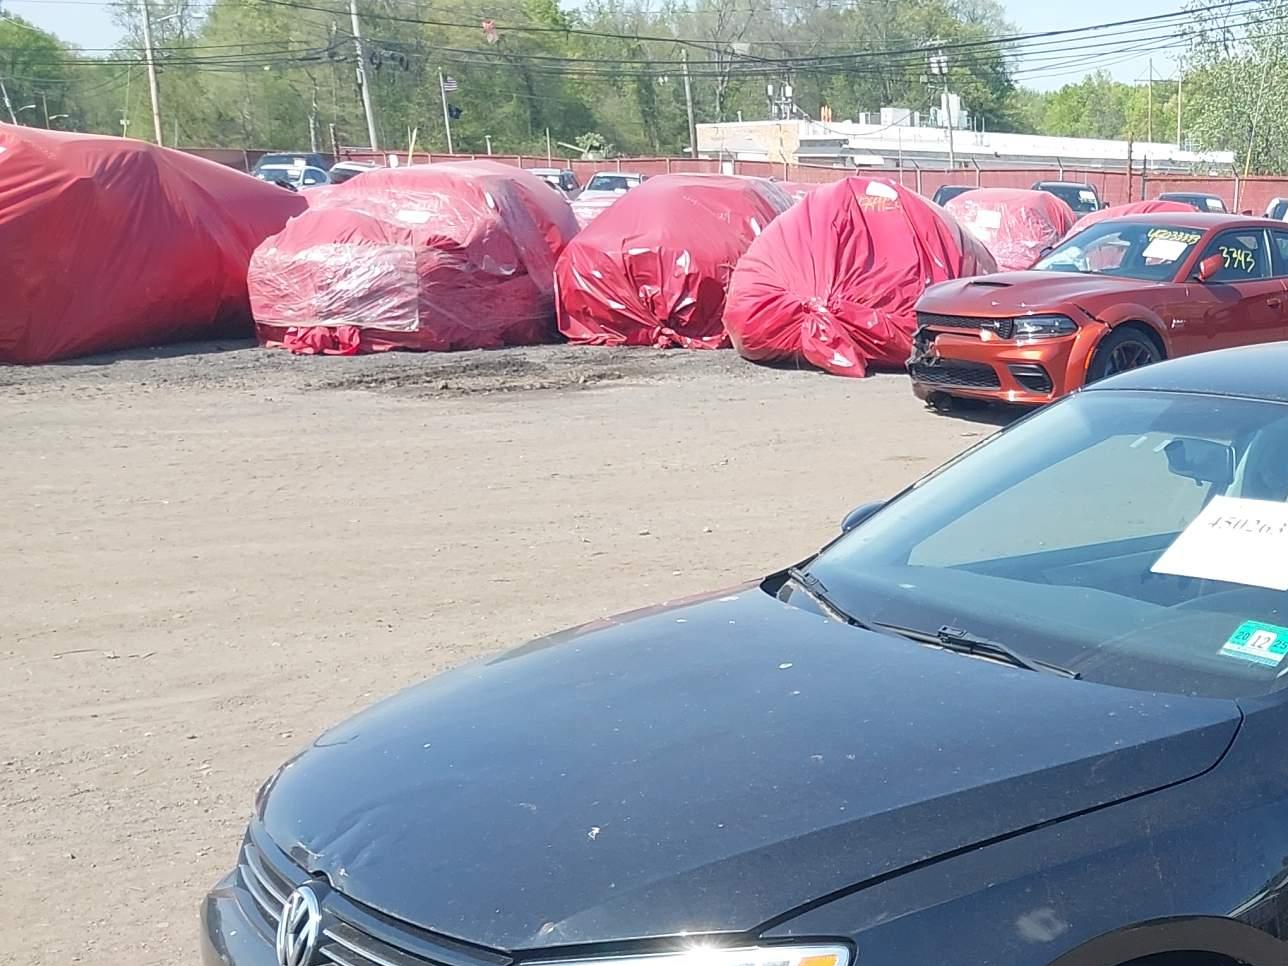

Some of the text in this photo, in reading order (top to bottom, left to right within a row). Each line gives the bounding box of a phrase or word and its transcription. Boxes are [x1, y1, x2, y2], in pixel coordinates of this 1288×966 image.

[1235, 631, 1251, 641] 20
[1250, 635, 1272, 649] 12
[1273, 640, 1288, 650] 25
